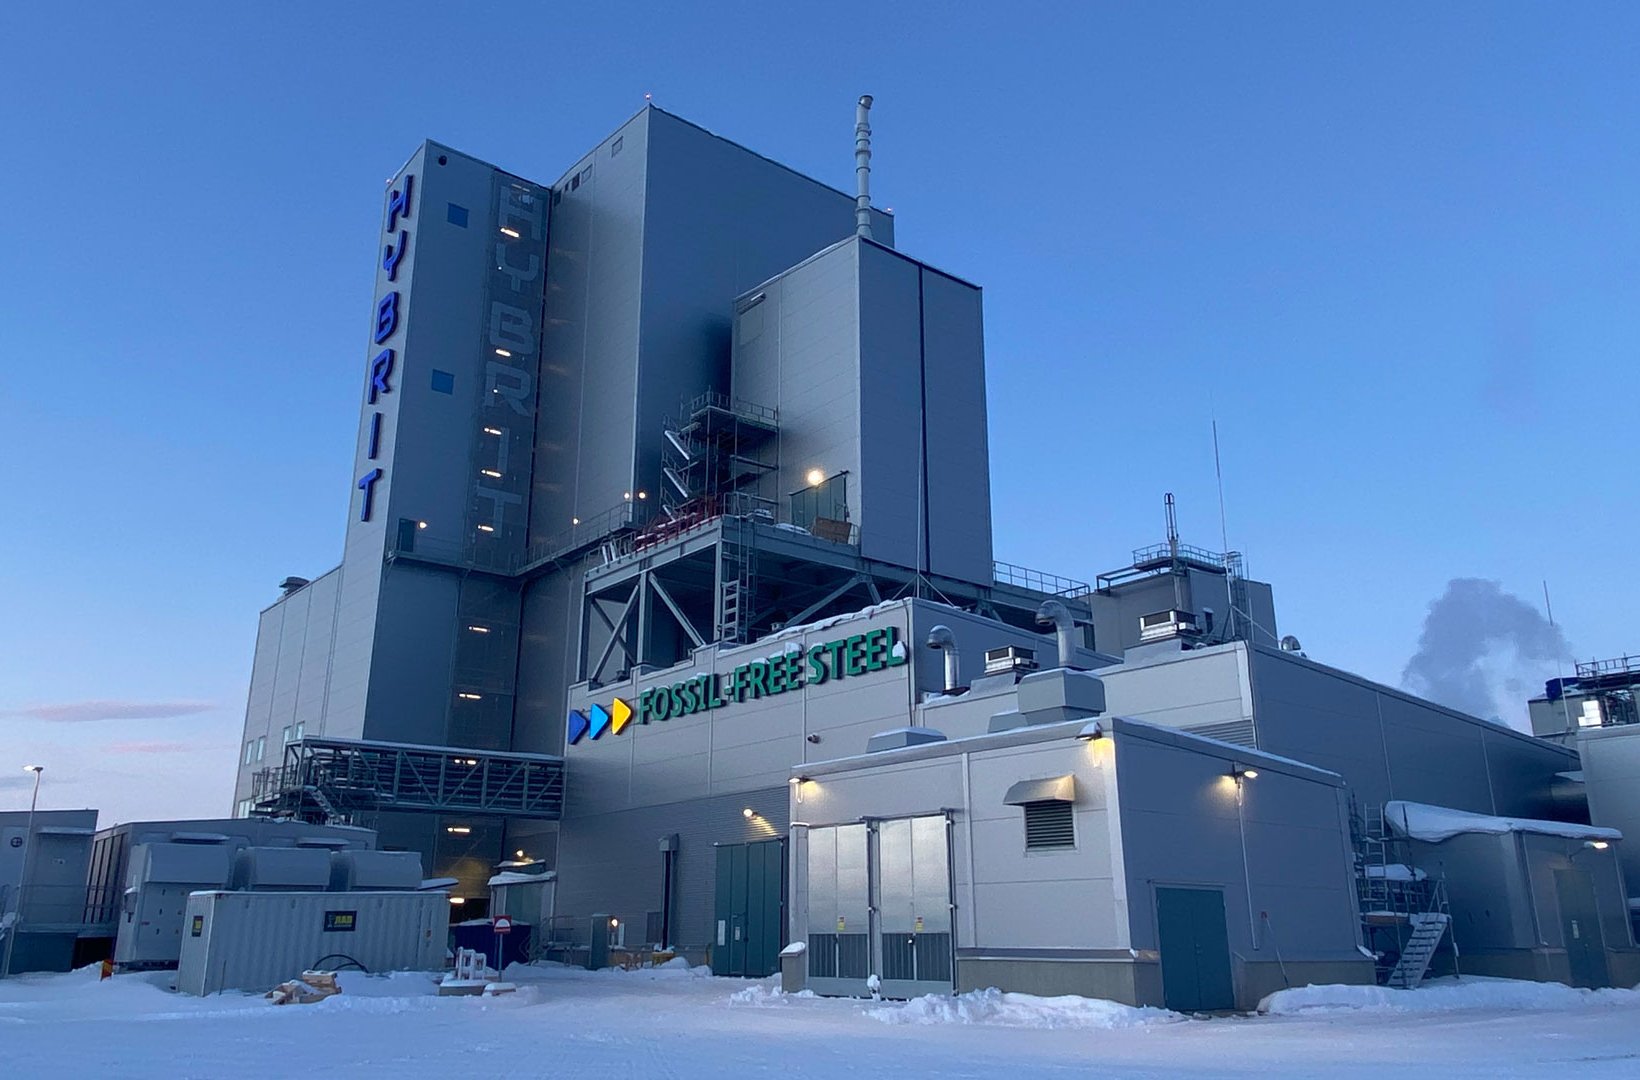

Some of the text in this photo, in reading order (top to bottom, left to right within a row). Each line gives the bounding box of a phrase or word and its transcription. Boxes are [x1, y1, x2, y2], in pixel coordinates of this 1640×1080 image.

[358, 174, 414, 522] HYBRIT
[639, 626, 907, 724] FOSSIL-FREE STEEL
